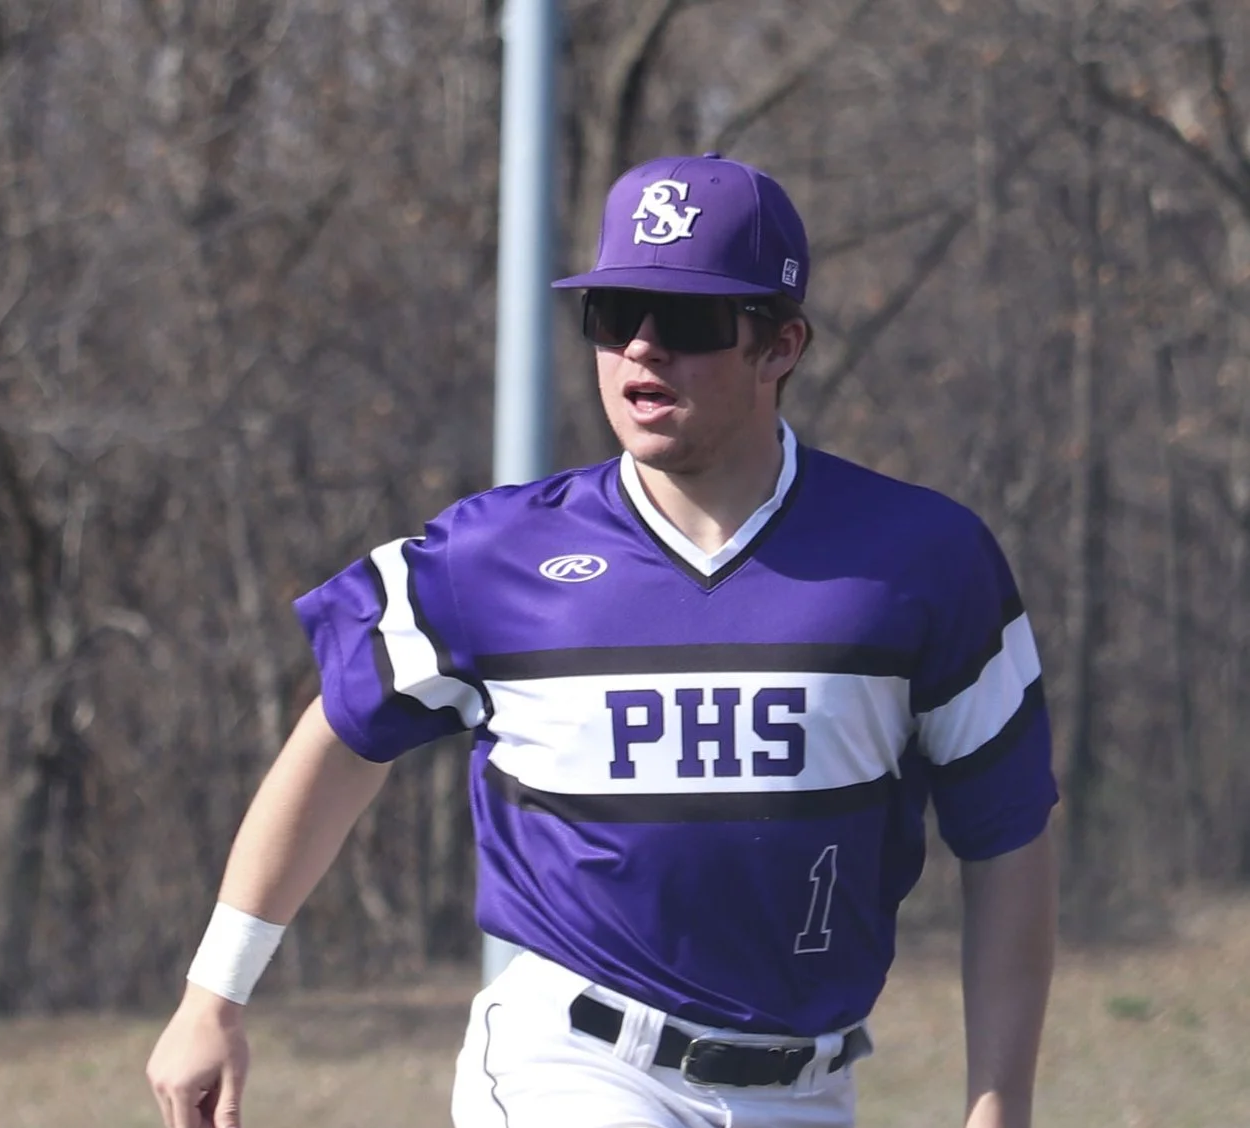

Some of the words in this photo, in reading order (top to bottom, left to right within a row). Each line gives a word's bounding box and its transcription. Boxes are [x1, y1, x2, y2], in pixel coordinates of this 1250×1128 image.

[546, 555, 595, 577] R
[605, 687, 807, 780] PHS
[793, 844, 838, 954] 1
